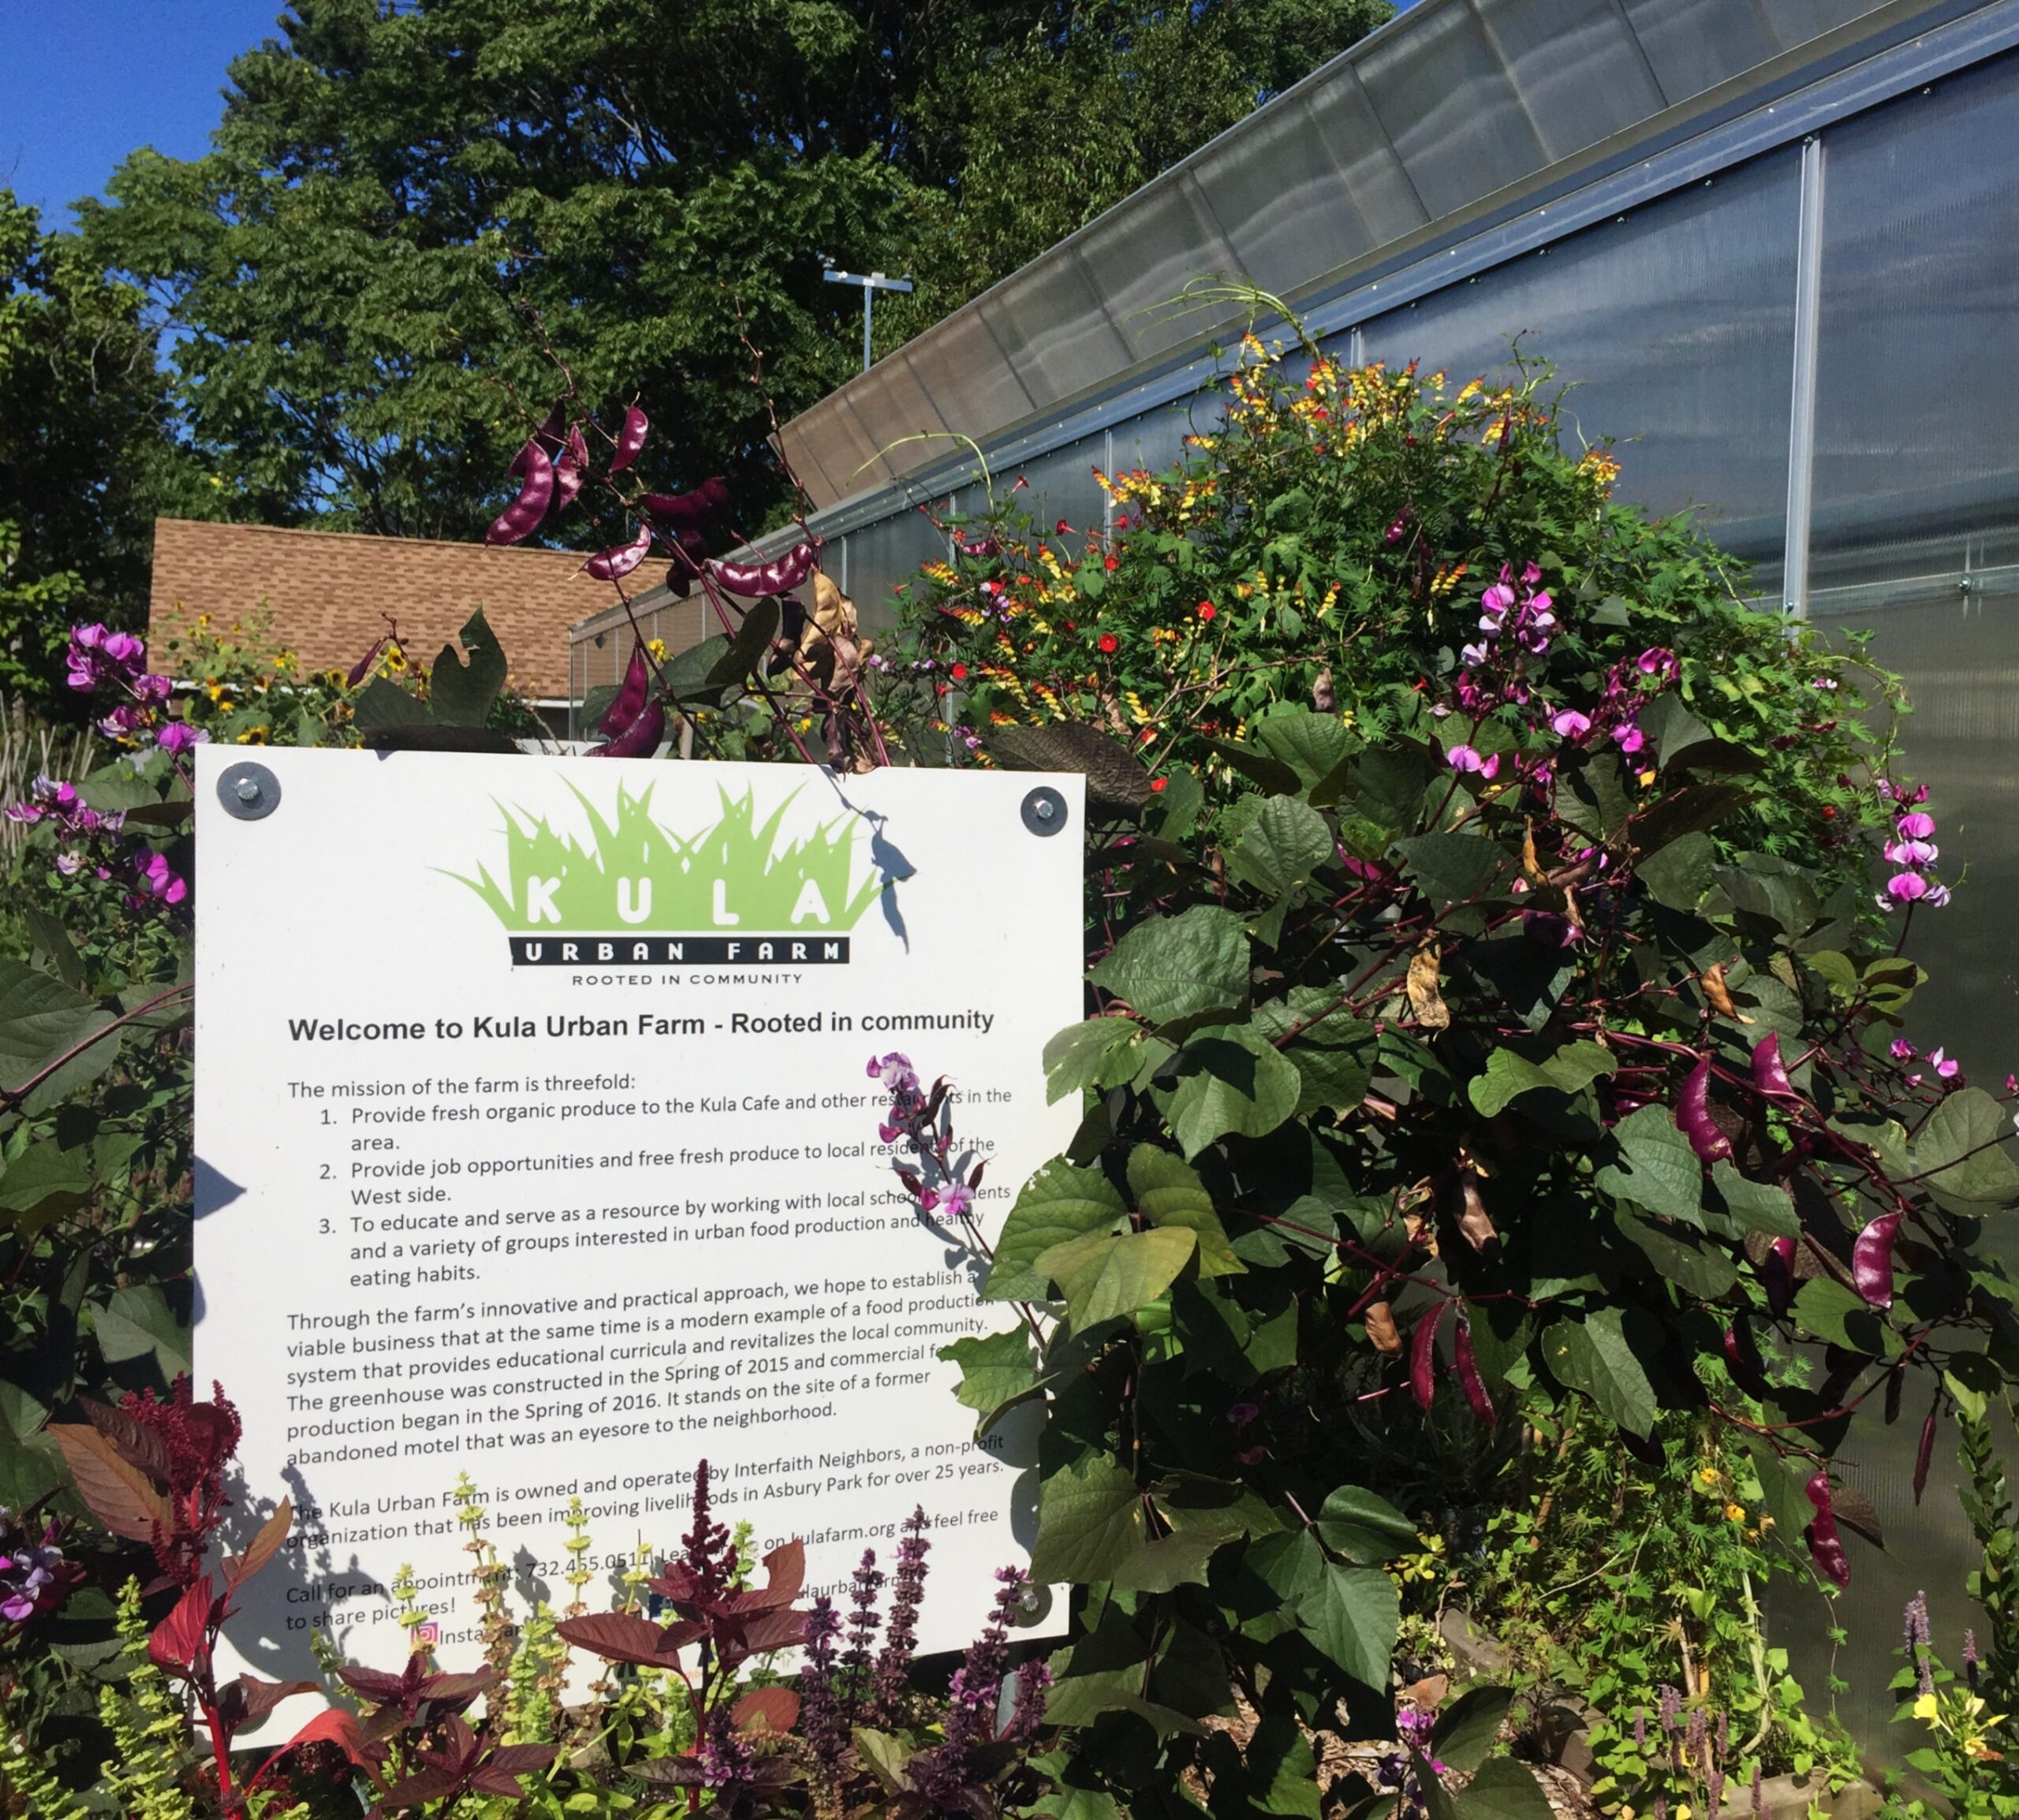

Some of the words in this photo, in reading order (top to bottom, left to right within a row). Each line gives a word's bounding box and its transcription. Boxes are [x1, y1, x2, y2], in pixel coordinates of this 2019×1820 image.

[528, 875, 830, 925] KULA
[525, 942, 684, 961] URBAN
[727, 942, 839, 960] FARM
[572, 975, 653, 986] ROOTED
[662, 975, 681, 985] IN
[689, 973, 803, 985] COMMUNITY
[287, 1018, 426, 1042] Welcome
[435, 1018, 464, 1039] to
[473, 1016, 536, 1039] Kula
[547, 1015, 629, 1038] Urban
[638, 1013, 705, 1035] Farm
[731, 1011, 823, 1034] Rooted
[831, 1011, 853, 1032] in
[860, 1009, 995, 1035] community
[287, 1080, 325, 1098] The
[331, 1080, 405, 1098] mission
[436, 1077, 469, 1095] the
[474, 1076, 519, 1094] farm
[544, 1072, 636, 1091] threefold:
[320, 1108, 338, 1125] 1.
[352, 1105, 426, 1124] Provide
[431, 1103, 480, 1121] fresh
[486, 1102, 555, 1123] organic
[561, 1099, 636, 1121] produce
[665, 1097, 695, 1114] the
[700, 1096, 737, 1113] Kula
[741, 1095, 780, 1111] Cafe
[785, 1093, 816, 1110] and
[821, 1092, 867, 1109] other
[986, 1088, 1012, 1103] the
[319, 1163, 337, 1180] 2.
[352, 1159, 426, 1179] Provide
[429, 1158, 461, 1179] job
[467, 1154, 595, 1177] opportunities
[599, 1151, 633, 1168] and
[638, 1150, 675, 1166] free
[679, 1147, 724, 1165] fresh
[730, 1145, 800, 1166] produce
[827, 1141, 864, 1158] local
[969, 1136, 995, 1151] the
[351, 1137, 400, 1151] area.
[319, 1218, 336, 1235] 3.
[349, 1216, 375, 1233] To
[380, 1213, 459, 1232] educate
[464, 1209, 499, 1227] and
[505, 1210, 556, 1225] serve
[561, 1209, 580, 1222] as
[602, 1204, 680, 1220] resource
[685, 1199, 707, 1218] by
[711, 1196, 781, 1214] working
[785, 1193, 822, 1210] with
[827, 1191, 865, 1208] local
[350, 1188, 402, 1206] West
[407, 1185, 451, 1203] side.
[350, 1241, 386, 1260] and
[409, 1239, 476, 1258] variety
[481, 1235, 502, 1254] of
[506, 1236, 570, 1256] groups
[575, 1225, 667, 1248] interested
[695, 1223, 745, 1240] urban
[750, 1219, 789, 1237] food
[794, 1217, 886, 1238] production
[890, 1215, 920, 1230] and
[349, 1269, 411, 1288] eating
[417, 1265, 480, 1283] habits.
[286, 1309, 370, 1331] Through
[375, 1307, 409, 1325] the
[481, 1297, 578, 1318] innovative
[584, 1292, 617, 1311] and
[623, 1287, 698, 1312] practical
[703, 1281, 789, 1305] approach,
[794, 1283, 819, 1296] we
[824, 1278, 866, 1296] hope
[892, 1270, 962, 1289] establish
[286, 1338, 346, 1358] viable
[353, 1335, 435, 1353] business
[440, 1330, 480, 1347] that
[509, 1325, 541, 1342] the
[546, 1324, 595, 1340] same
[599, 1319, 641, 1336] time
[681, 1311, 748, 1330] modern
[754, 1303, 826, 1324] example
[830, 1301, 849, 1318] of
[866, 1297, 903, 1315] food
[287, 1367, 356, 1388] system
[362, 1362, 403, 1379] that
[409, 1355, 491, 1379] provides
[496, 1344, 604, 1370] educational
[610, 1339, 687, 1360] curricula
[692, 1336, 725, 1354] and
[730, 1331, 815, 1351] revitalizes
[819, 1327, 847, 1344] the
[852, 1322, 890, 1341] local
[894, 1318, 987, 1337] community.
[286, 1394, 323, 1412] The
[329, 1387, 445, 1412] greenhouse
[450, 1385, 487, 1400] was
[492, 1371, 603, 1396] constructed
[629, 1367, 659, 1385] the
[664, 1363, 720, 1385] Spring
[724, 1359, 743, 1377] of
[747, 1356, 789, 1374] 2015
[794, 1352, 825, 1371] and
[830, 1344, 924, 1367] commercial
[287, 1416, 395, 1443] production
[401, 1413, 460, 1431] began
[488, 1404, 520, 1423] the
[524, 1400, 584, 1423] Spring
[612, 1393, 661, 1412] 2016.
[667, 1391, 680, 1407] It
[685, 1385, 741, 1405] stands
[745, 1386, 767, 1400] on
[772, 1381, 801, 1397] the
[805, 1378, 835, 1394] site
[839, 1374, 857, 1391] of
[875, 1371, 931, 1388] former
[287, 1440, 397, 1466] abandoned
[404, 1434, 460, 1456] motel
[465, 1433, 505, 1451] that
[509, 1432, 546, 1447] was
[550, 1430, 573, 1443] an
[579, 1423, 650, 1443] eyesore
[655, 1419, 674, 1433] to
[678, 1414, 708, 1431] the
[713, 1401, 837, 1429] neighborhood.
[330, 1499, 370, 1518] Kula
[378, 1495, 435, 1513] Urban
[514, 1479, 578, 1501] owned
[584, 1475, 617, 1494] and
[709, 1465, 729, 1483] by
[734, 1455, 813, 1478] Interfaith
[819, 1448, 905, 1469] Neighbors,
[286, 1524, 408, 1550] organization
[413, 1519, 453, 1536] that
[497, 1509, 543, 1528] been
[744, 1486, 759, 1501] in
[763, 1482, 822, 1500] Asbury
[827, 1474, 863, 1493] Park
[867, 1471, 890, 1487] for
[894, 1469, 931, 1484] over
[935, 1463, 954, 1480] 25
[958, 1461, 1004, 1480] years.
[286, 1586, 321, 1603] Call
[327, 1583, 356, 1599] for
[361, 1583, 384, 1595] an
[934, 1511, 963, 1529] feel
[968, 1509, 998, 1524] free
[286, 1616, 306, 1630] to
[312, 1611, 366, 1627] share
